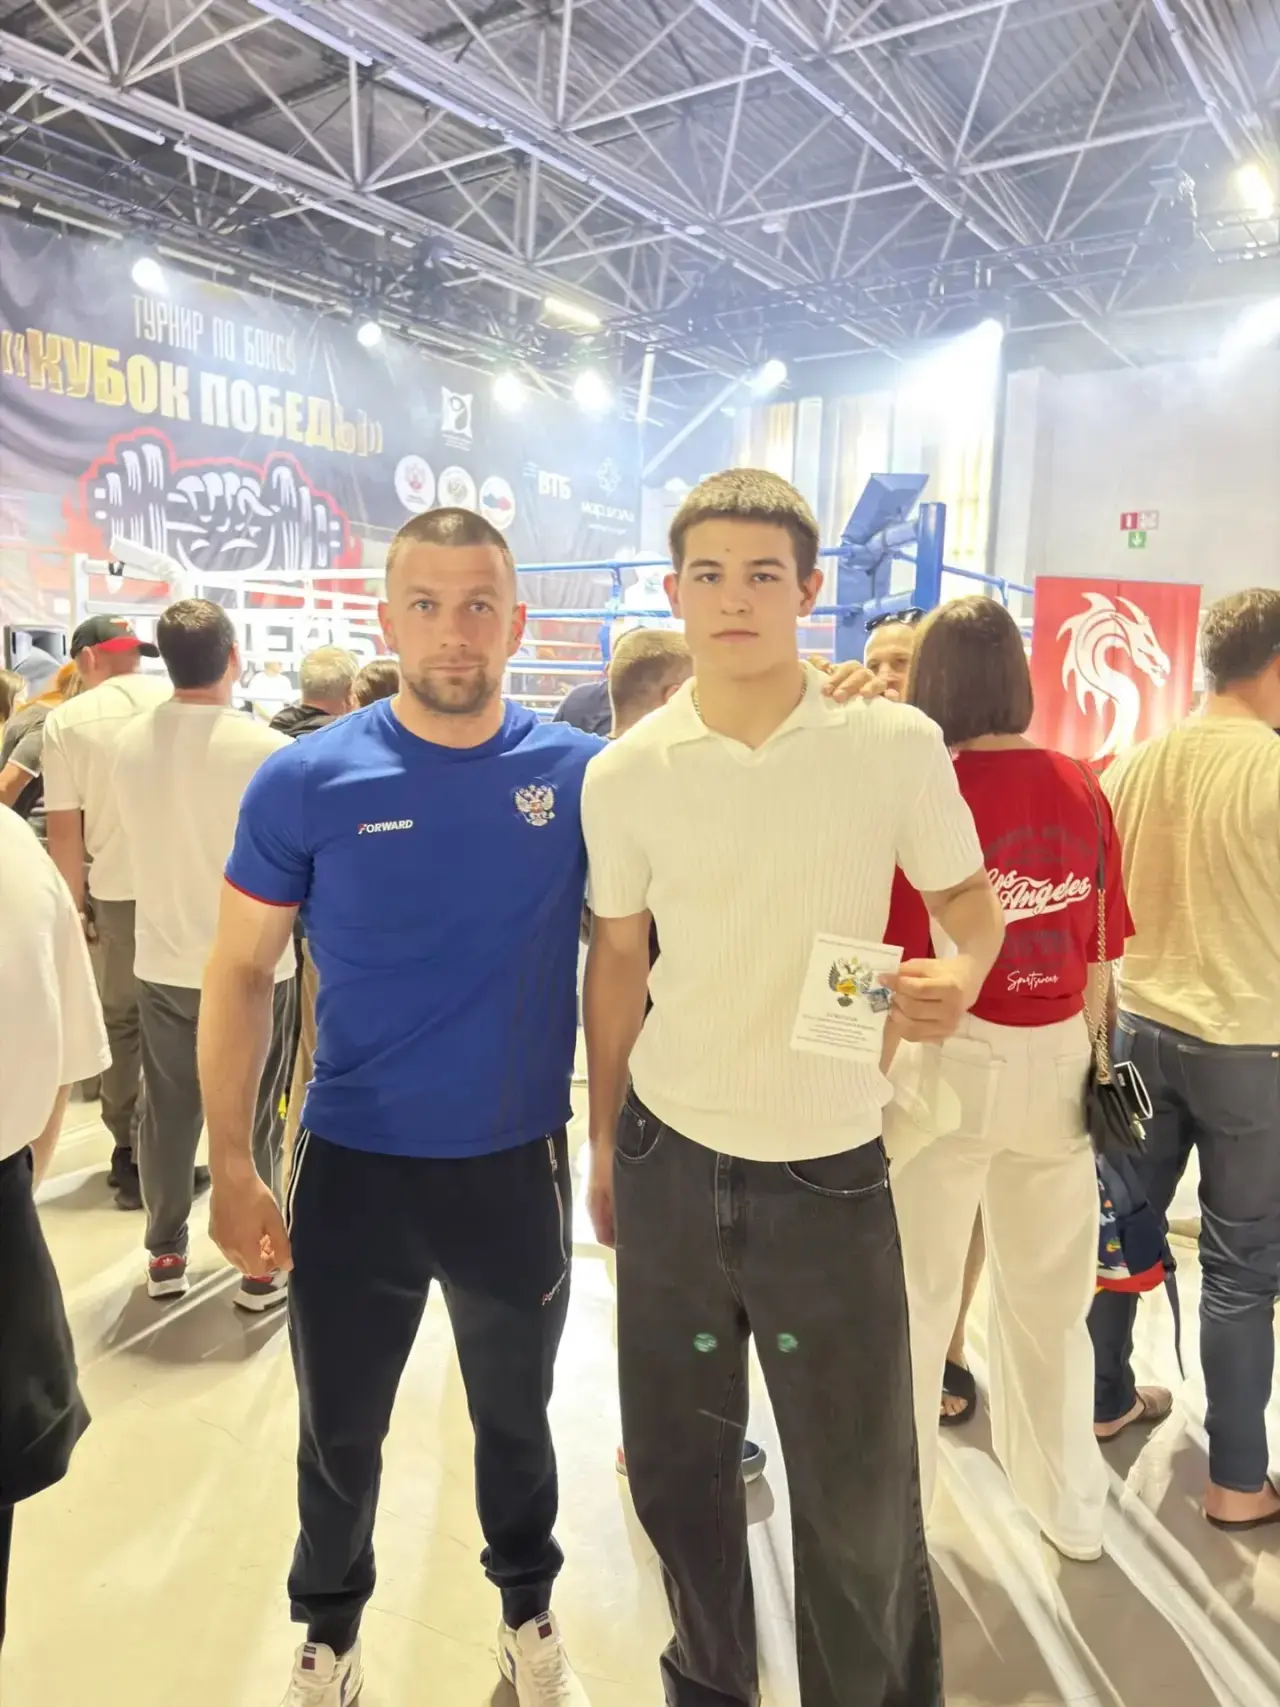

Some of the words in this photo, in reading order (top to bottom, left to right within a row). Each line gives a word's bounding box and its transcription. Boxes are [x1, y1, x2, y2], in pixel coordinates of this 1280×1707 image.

[131, 294, 204, 352] ТУРНИР
[212, 315, 236, 362] ПО
[243, 324, 297, 376] БОКСУ
[538, 469, 572, 500] ВТБ
[357, 819, 414, 835] FORWARD
[1000, 872, 1092, 915] Angeles
[1006, 970, 1060, 993] Sportswear
